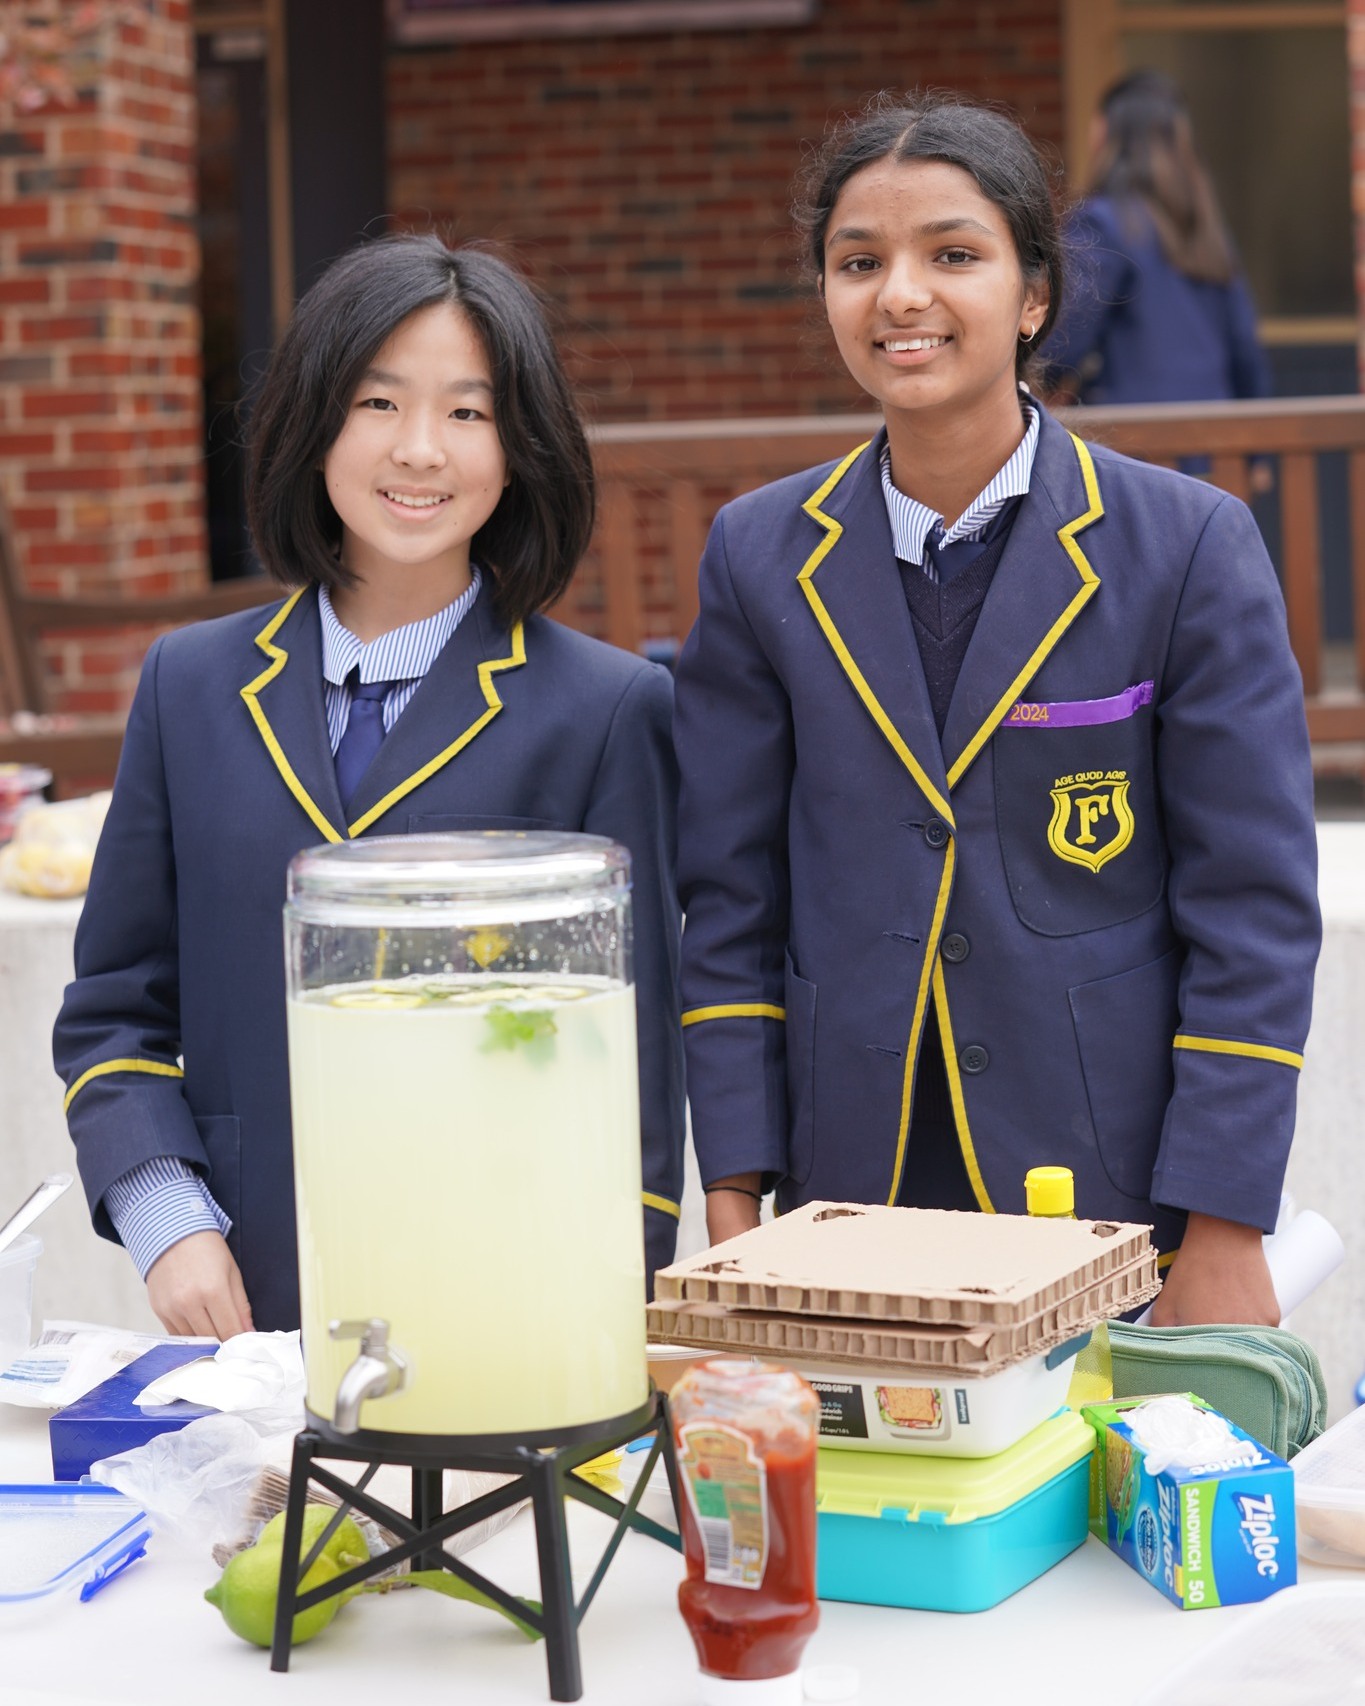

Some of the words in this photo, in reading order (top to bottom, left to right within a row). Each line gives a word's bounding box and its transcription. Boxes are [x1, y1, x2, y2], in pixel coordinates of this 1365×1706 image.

[1010, 703, 1050, 722] 2024
[1054, 775, 1074, 788] AGE
[1075, 771, 1103, 782] QUOD
[1104, 770, 1127, 780] AGIS
[1074, 794, 1110, 846] F
[811, 1382, 832, 1392] GOOD
[832, 1384, 853, 1393] GRIPS
[1156, 1478, 1174, 1588] Ziploc
[1186, 1487, 1202, 1572] SANDWICH
[1239, 1494, 1279, 1576] Ziploc
[1188, 1580, 1205, 1603] 50
